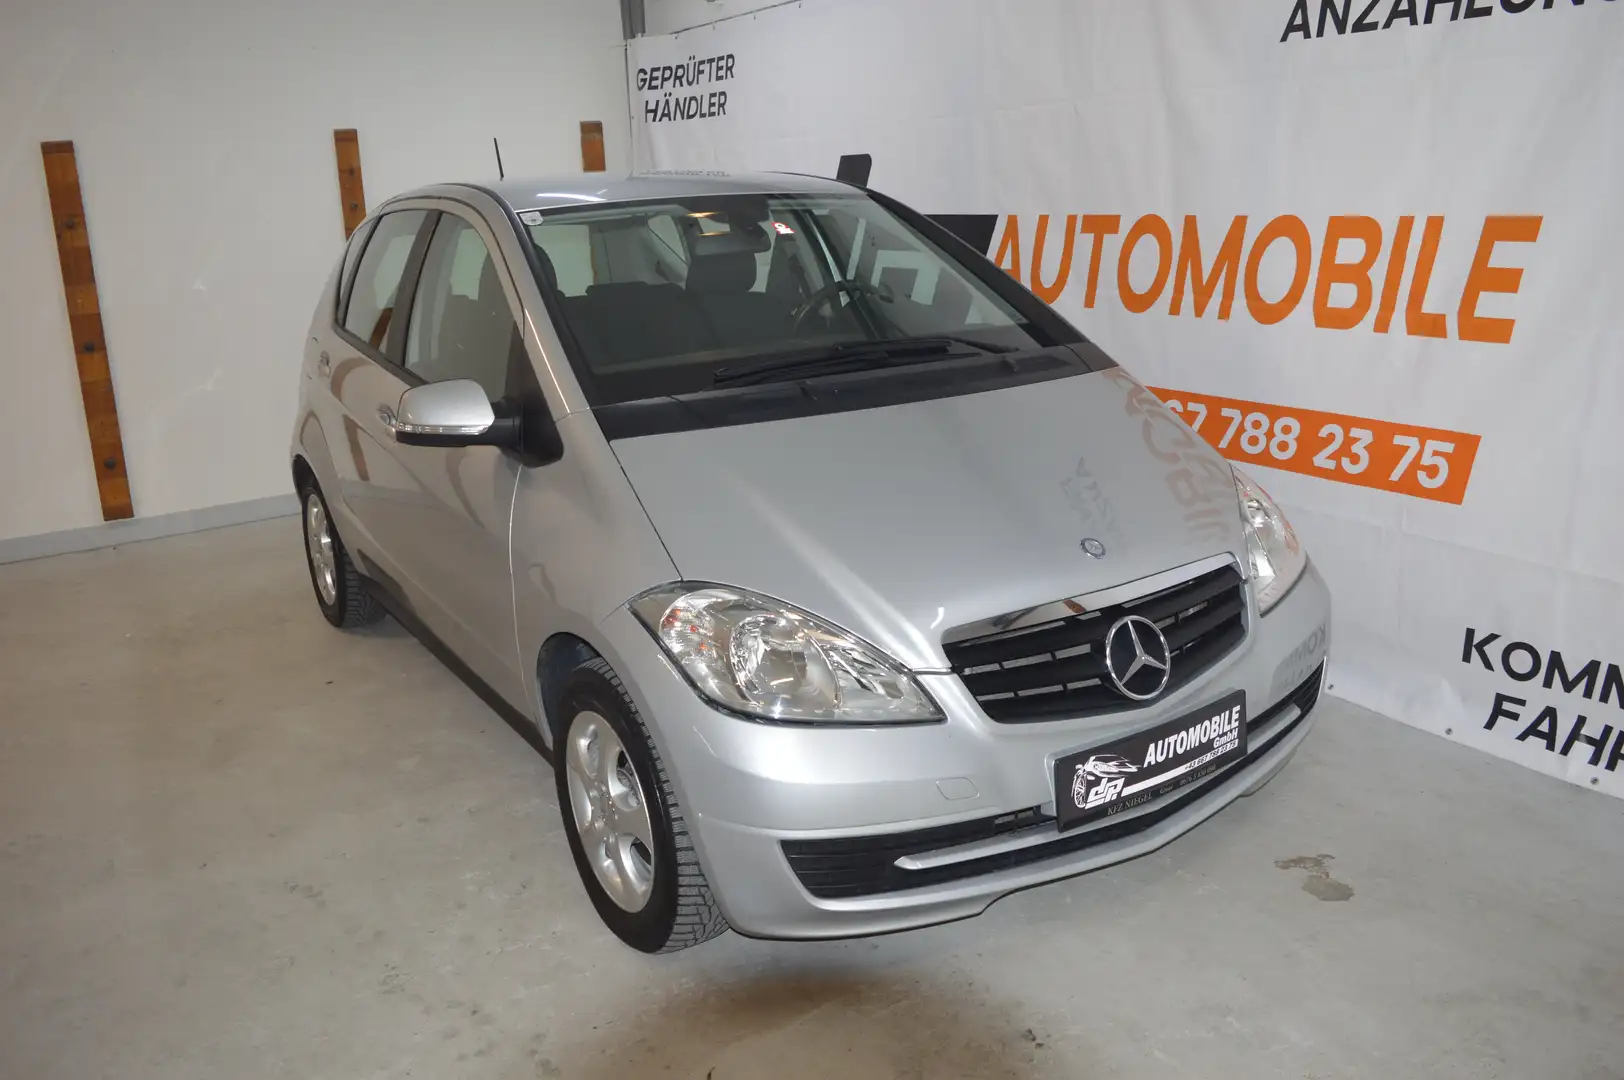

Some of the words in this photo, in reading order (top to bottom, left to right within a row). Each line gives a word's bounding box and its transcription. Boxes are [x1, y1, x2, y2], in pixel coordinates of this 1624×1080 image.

[636, 53, 735, 92] GEPRÜFTER
[645, 90, 727, 123] HÄNDLER
[993, 213, 1543, 344] AUTOMOBILE
[1218, 407, 1301, 461] 788
[1312, 424, 1375, 475] 23
[1388, 435, 1455, 489] 75
[1143, 704, 1241, 769] AUTOMOBILE
[1213, 727, 1239, 749] GmbH
[1184, 759, 1196, 770] +43
[1107, 803, 1123, 816] KFZ
[1124, 792, 1153, 809] NIEGEL
